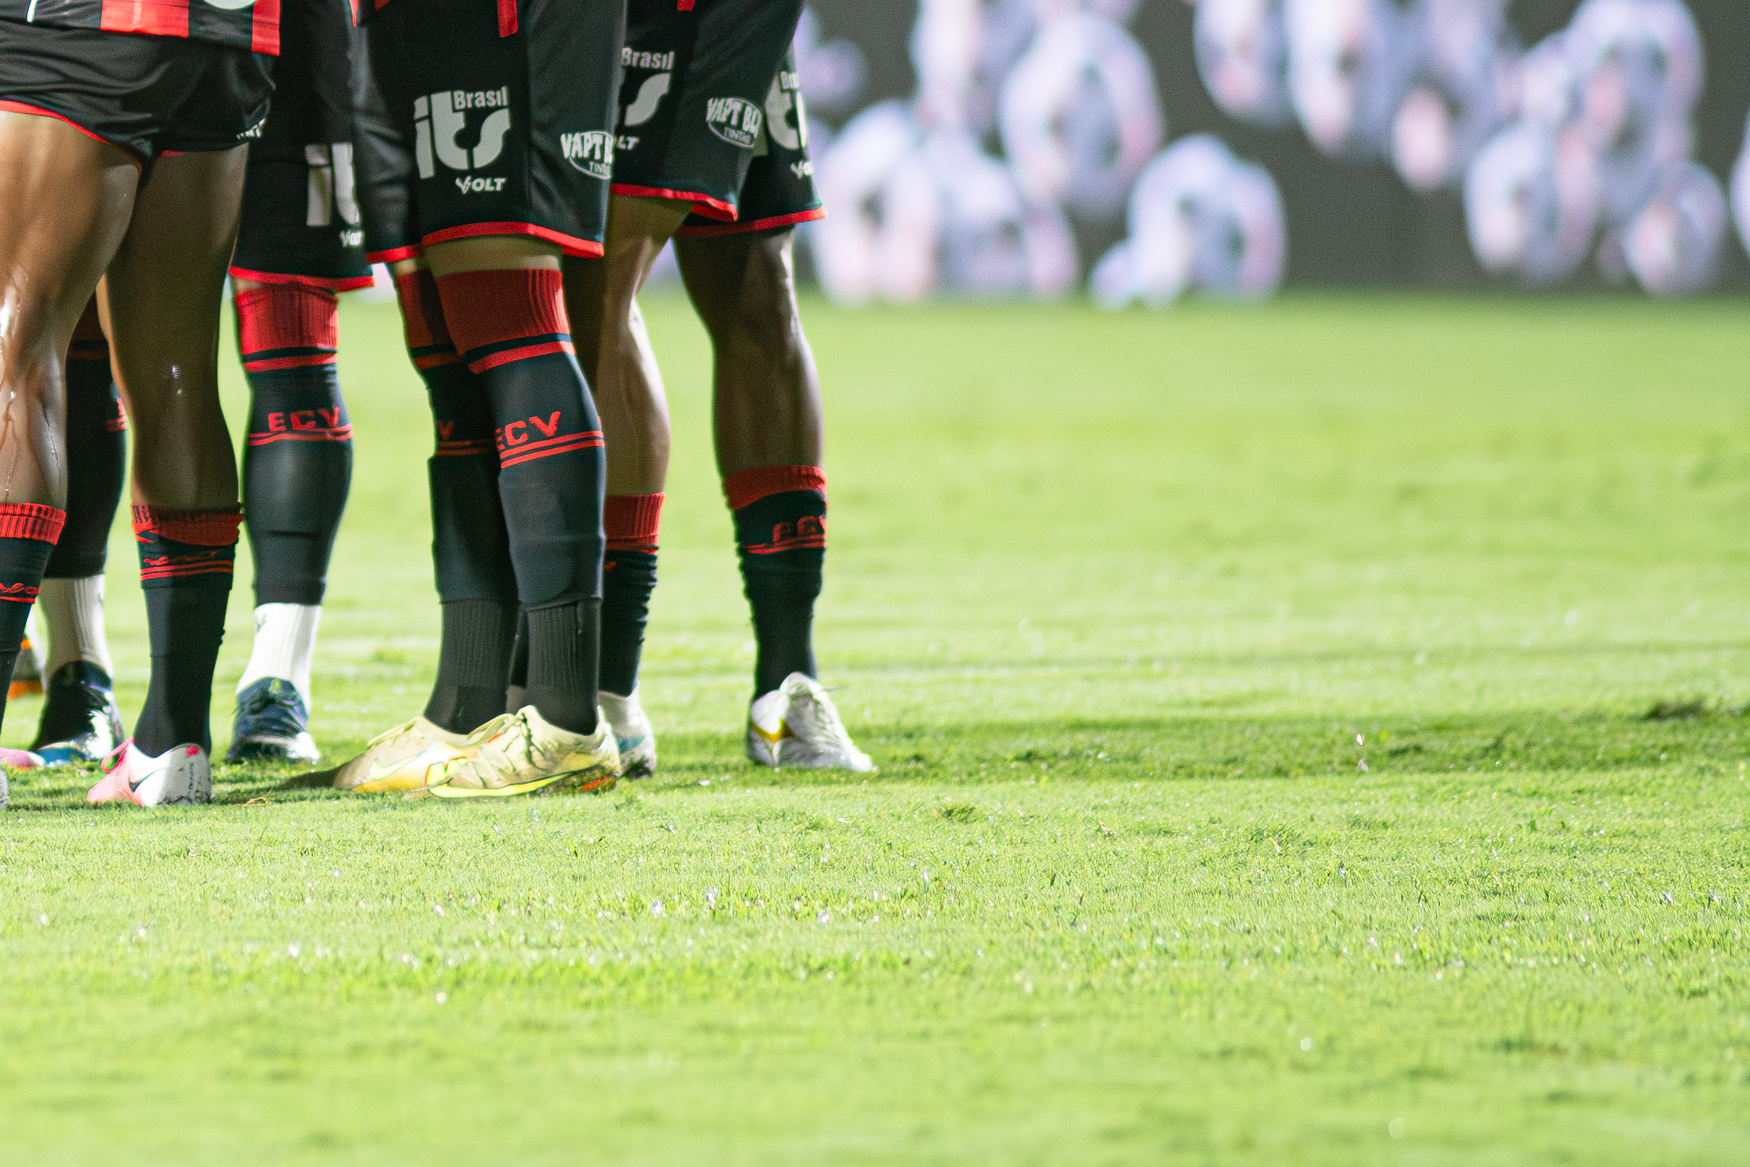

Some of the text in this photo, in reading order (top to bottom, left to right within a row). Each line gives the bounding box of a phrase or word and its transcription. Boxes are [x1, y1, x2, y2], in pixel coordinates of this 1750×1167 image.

[622, 47, 674, 70] Brasil
[454, 85, 508, 109] Brasil
[706, 98, 743, 125] VAPT
[560, 133, 603, 160] VAPT
[455, 175, 507, 194] VOLT
[268, 406, 340, 431] ECV
